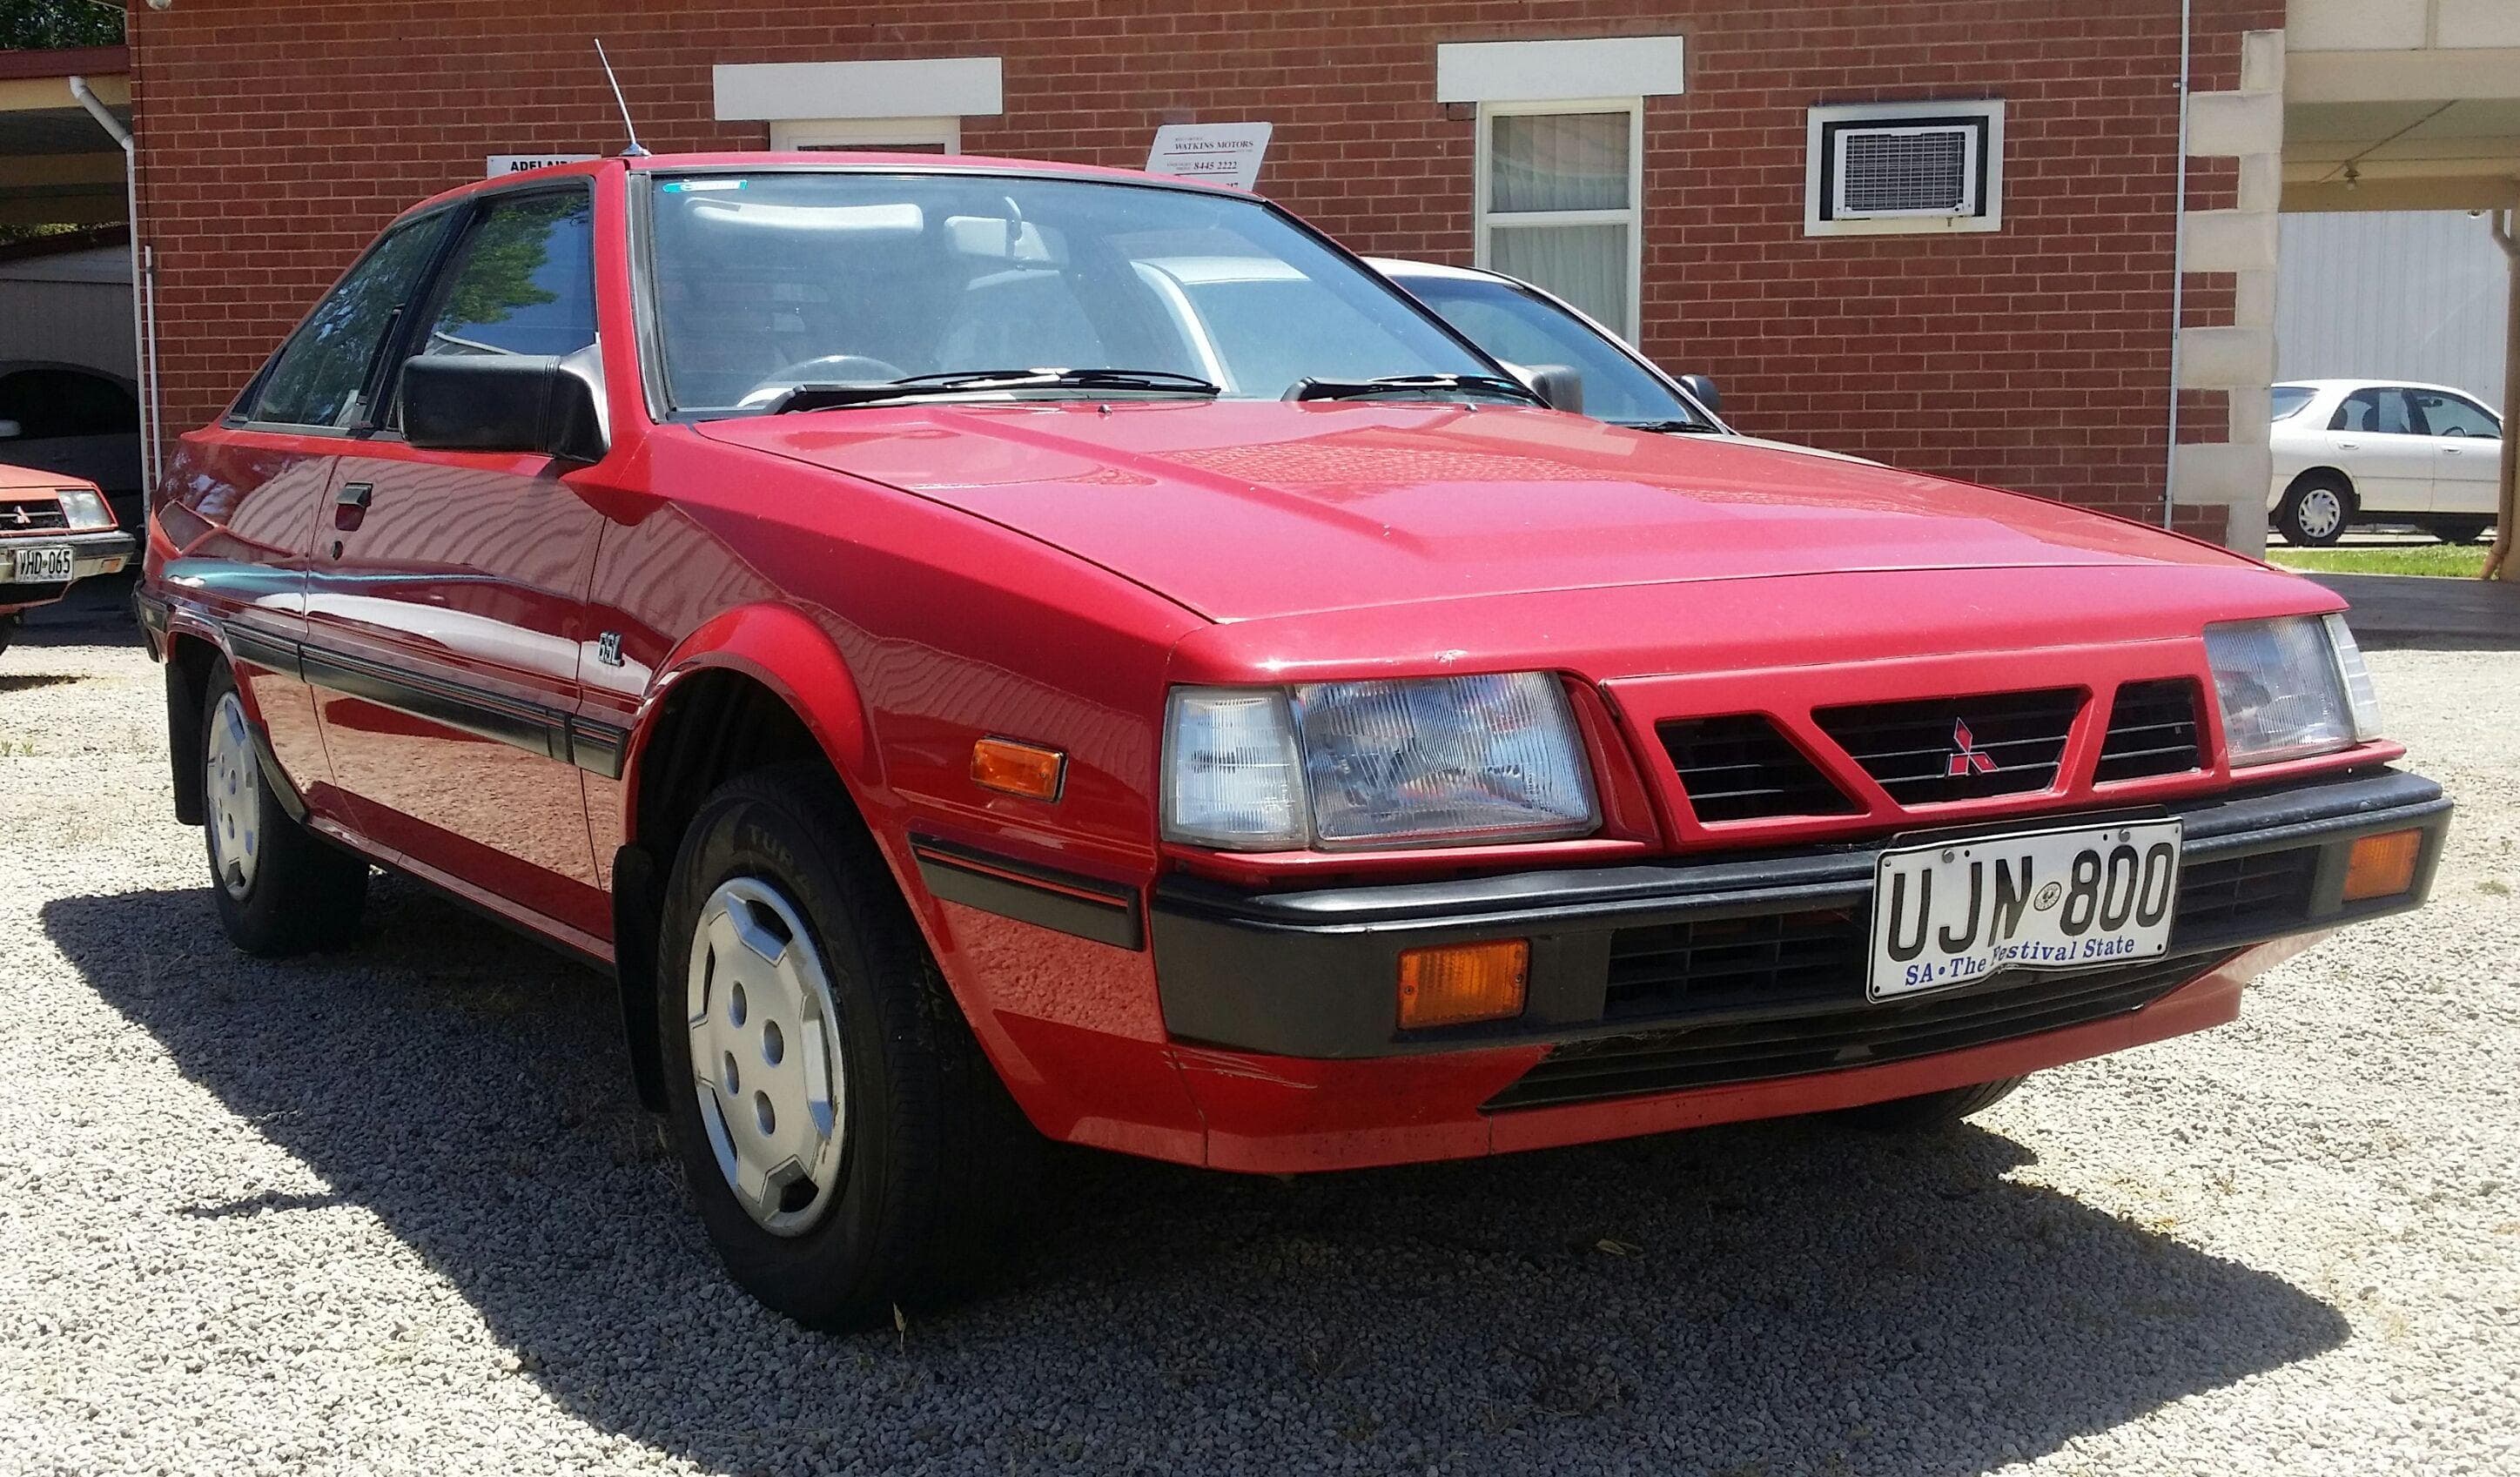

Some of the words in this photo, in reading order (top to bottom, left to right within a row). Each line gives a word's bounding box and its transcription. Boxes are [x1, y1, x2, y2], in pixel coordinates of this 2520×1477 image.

[1174, 141, 1214, 151] WATKINS
[1217, 140, 1254, 149] MOTORS
[510, 161, 572, 171] ADELA
[1193, 161, 1214, 170] 8445
[1217, 161, 1238, 170] 2222
[49, 550, 70, 574] 065
[1888, 856, 2033, 962] UJN
[2060, 843, 2174, 937] 800
[1905, 963, 1933, 986] SA
[1950, 956, 1986, 977] The
[1990, 941, 2076, 966] Festival
[2082, 936, 2134, 958] State
